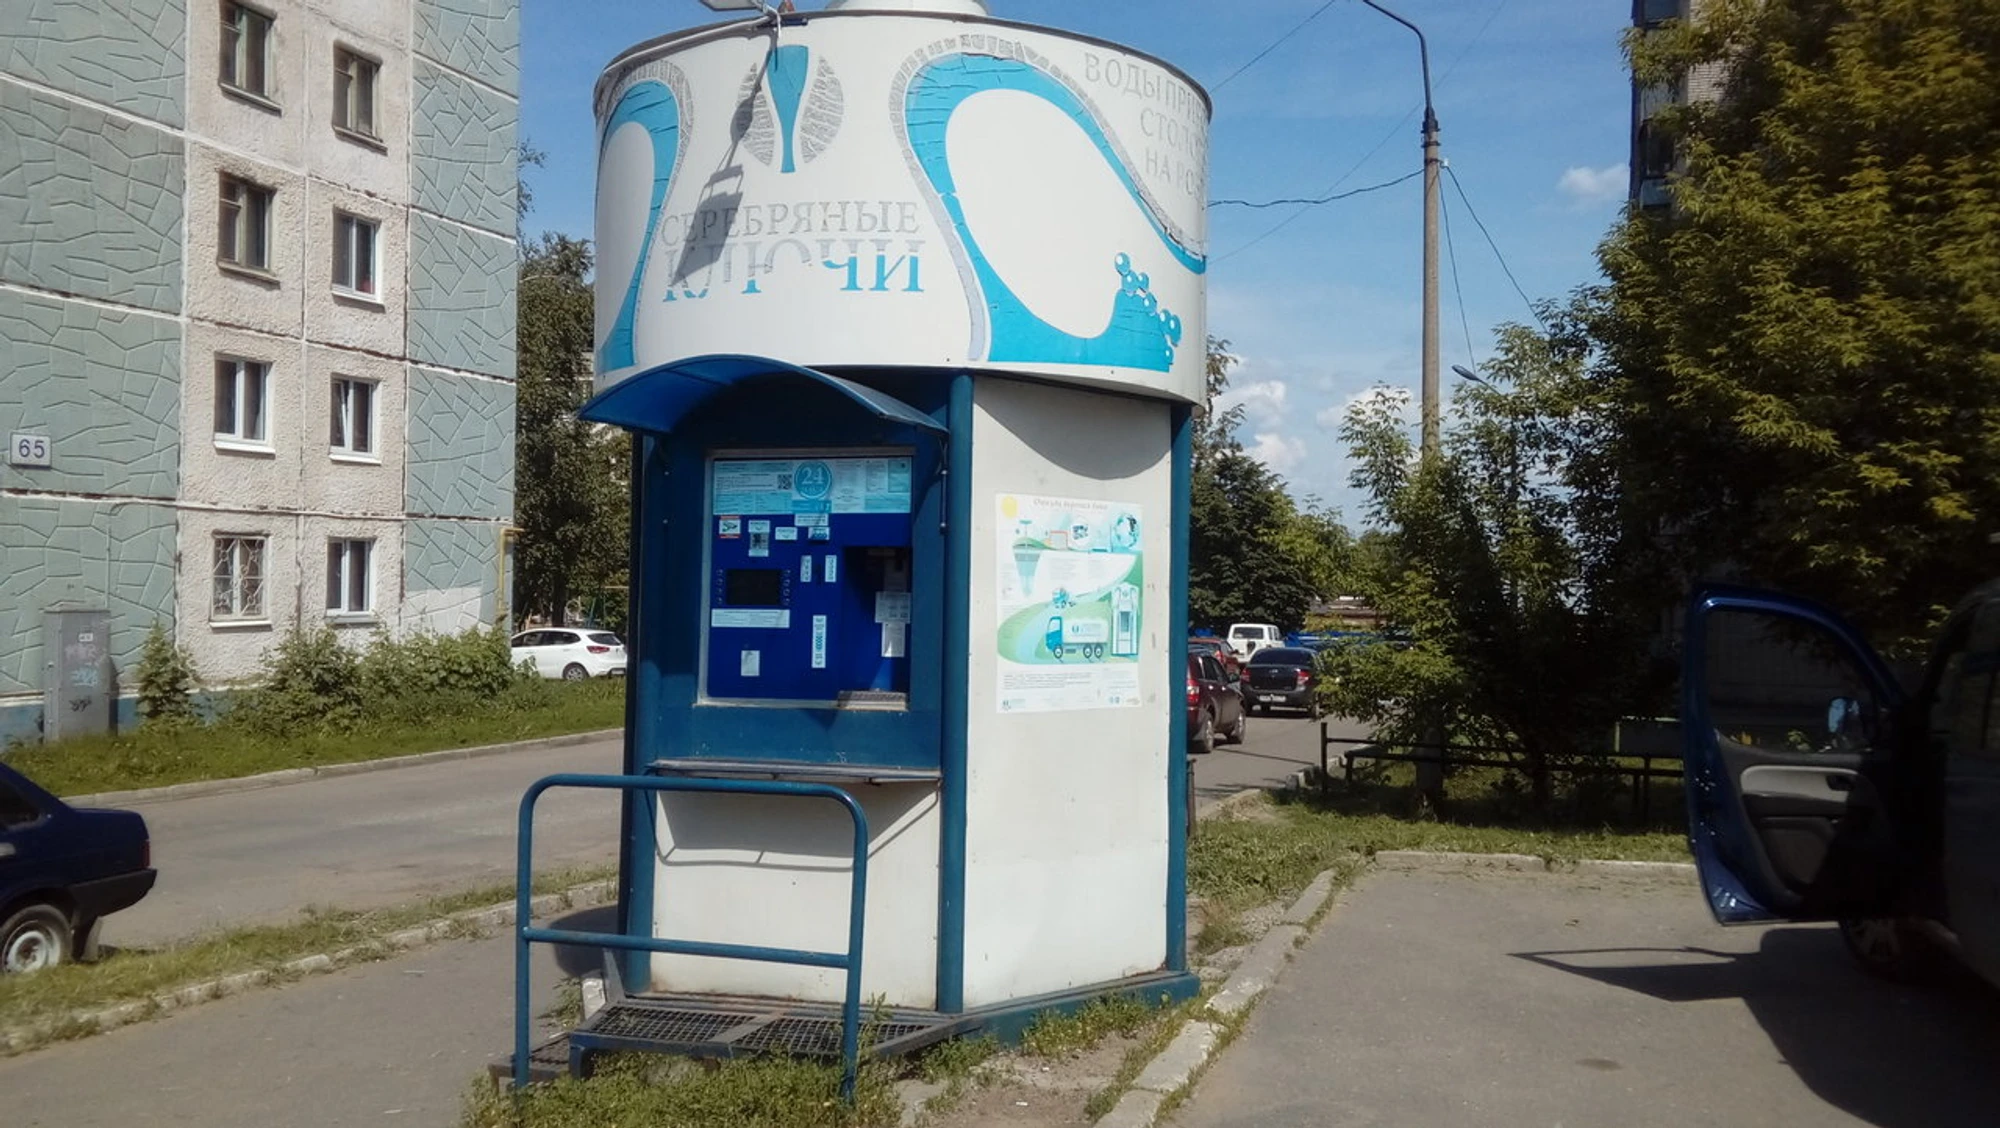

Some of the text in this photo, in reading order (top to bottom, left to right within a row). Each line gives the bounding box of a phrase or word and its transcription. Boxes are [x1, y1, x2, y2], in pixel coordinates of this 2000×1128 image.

[1084, 52, 1161, 101] ВОДЫ
[1145, 147, 1171, 183] НА
[660, 200, 920, 247] СЕРЕБРЯНЫЕ
[19, 438, 45, 459] 65
[801, 466, 824, 485] 24
